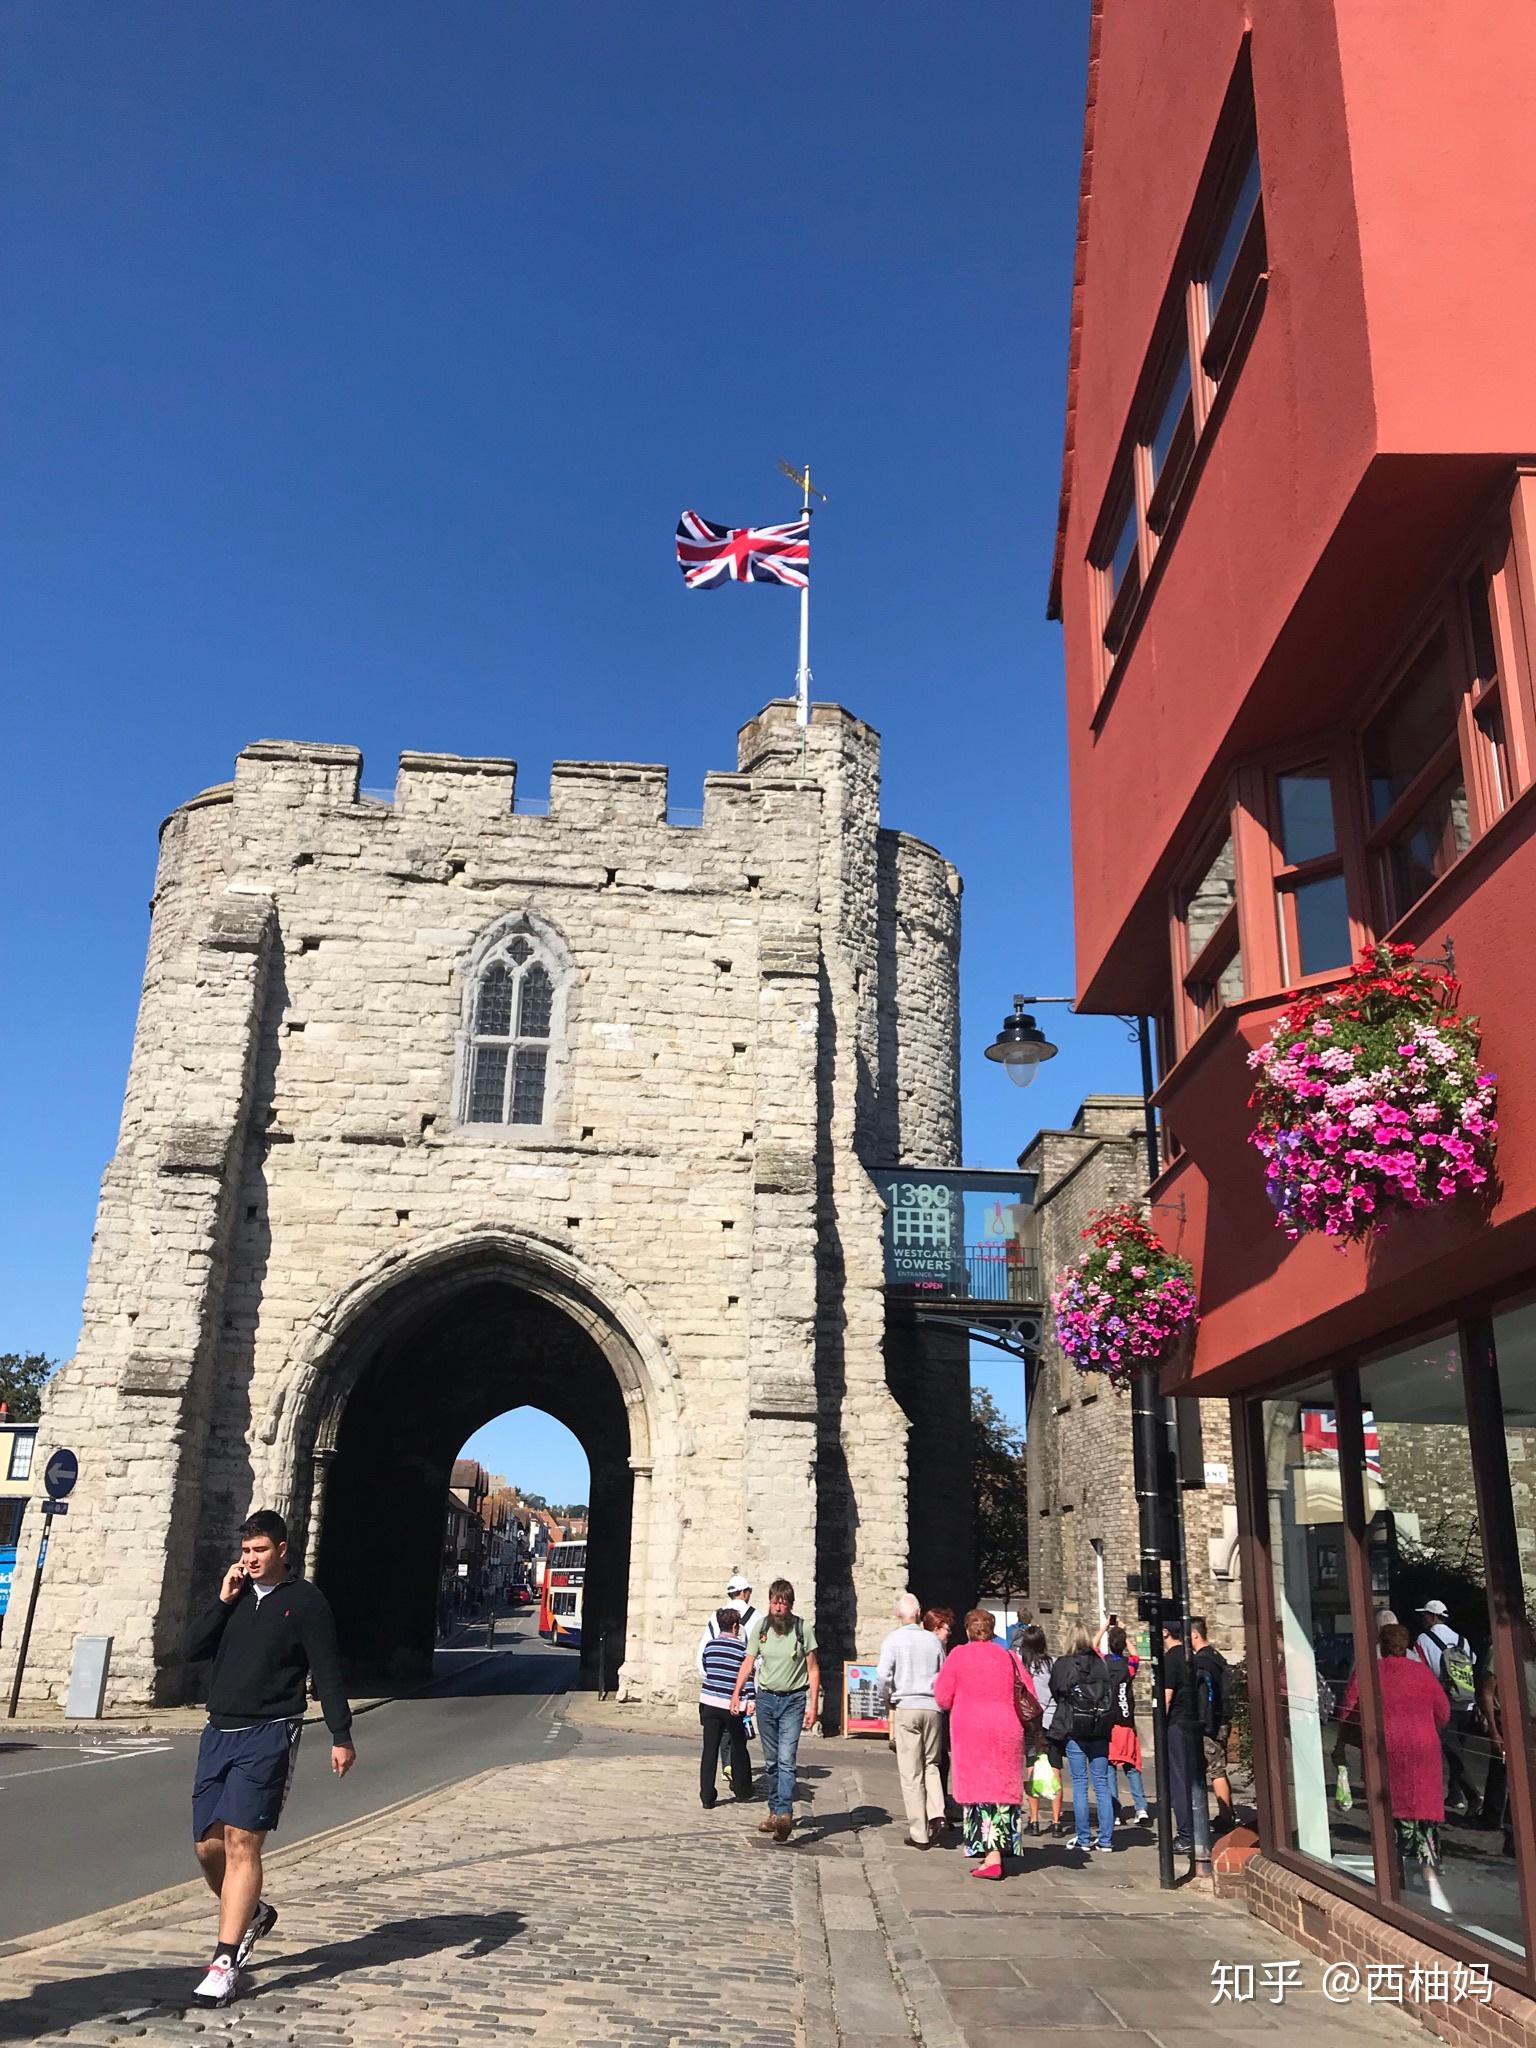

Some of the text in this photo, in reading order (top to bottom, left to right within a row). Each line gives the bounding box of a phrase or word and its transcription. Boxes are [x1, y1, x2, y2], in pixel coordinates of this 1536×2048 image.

[887, 1183, 950, 1208] 1380
[893, 1248, 951, 1259] WESTGATE
[893, 1258, 952, 1271] TOWERS
[897, 1270, 933, 1279] ENTRANCE
[922, 1281, 944, 1290] OPEN
[1117, 1682, 1130, 1718] adidas
